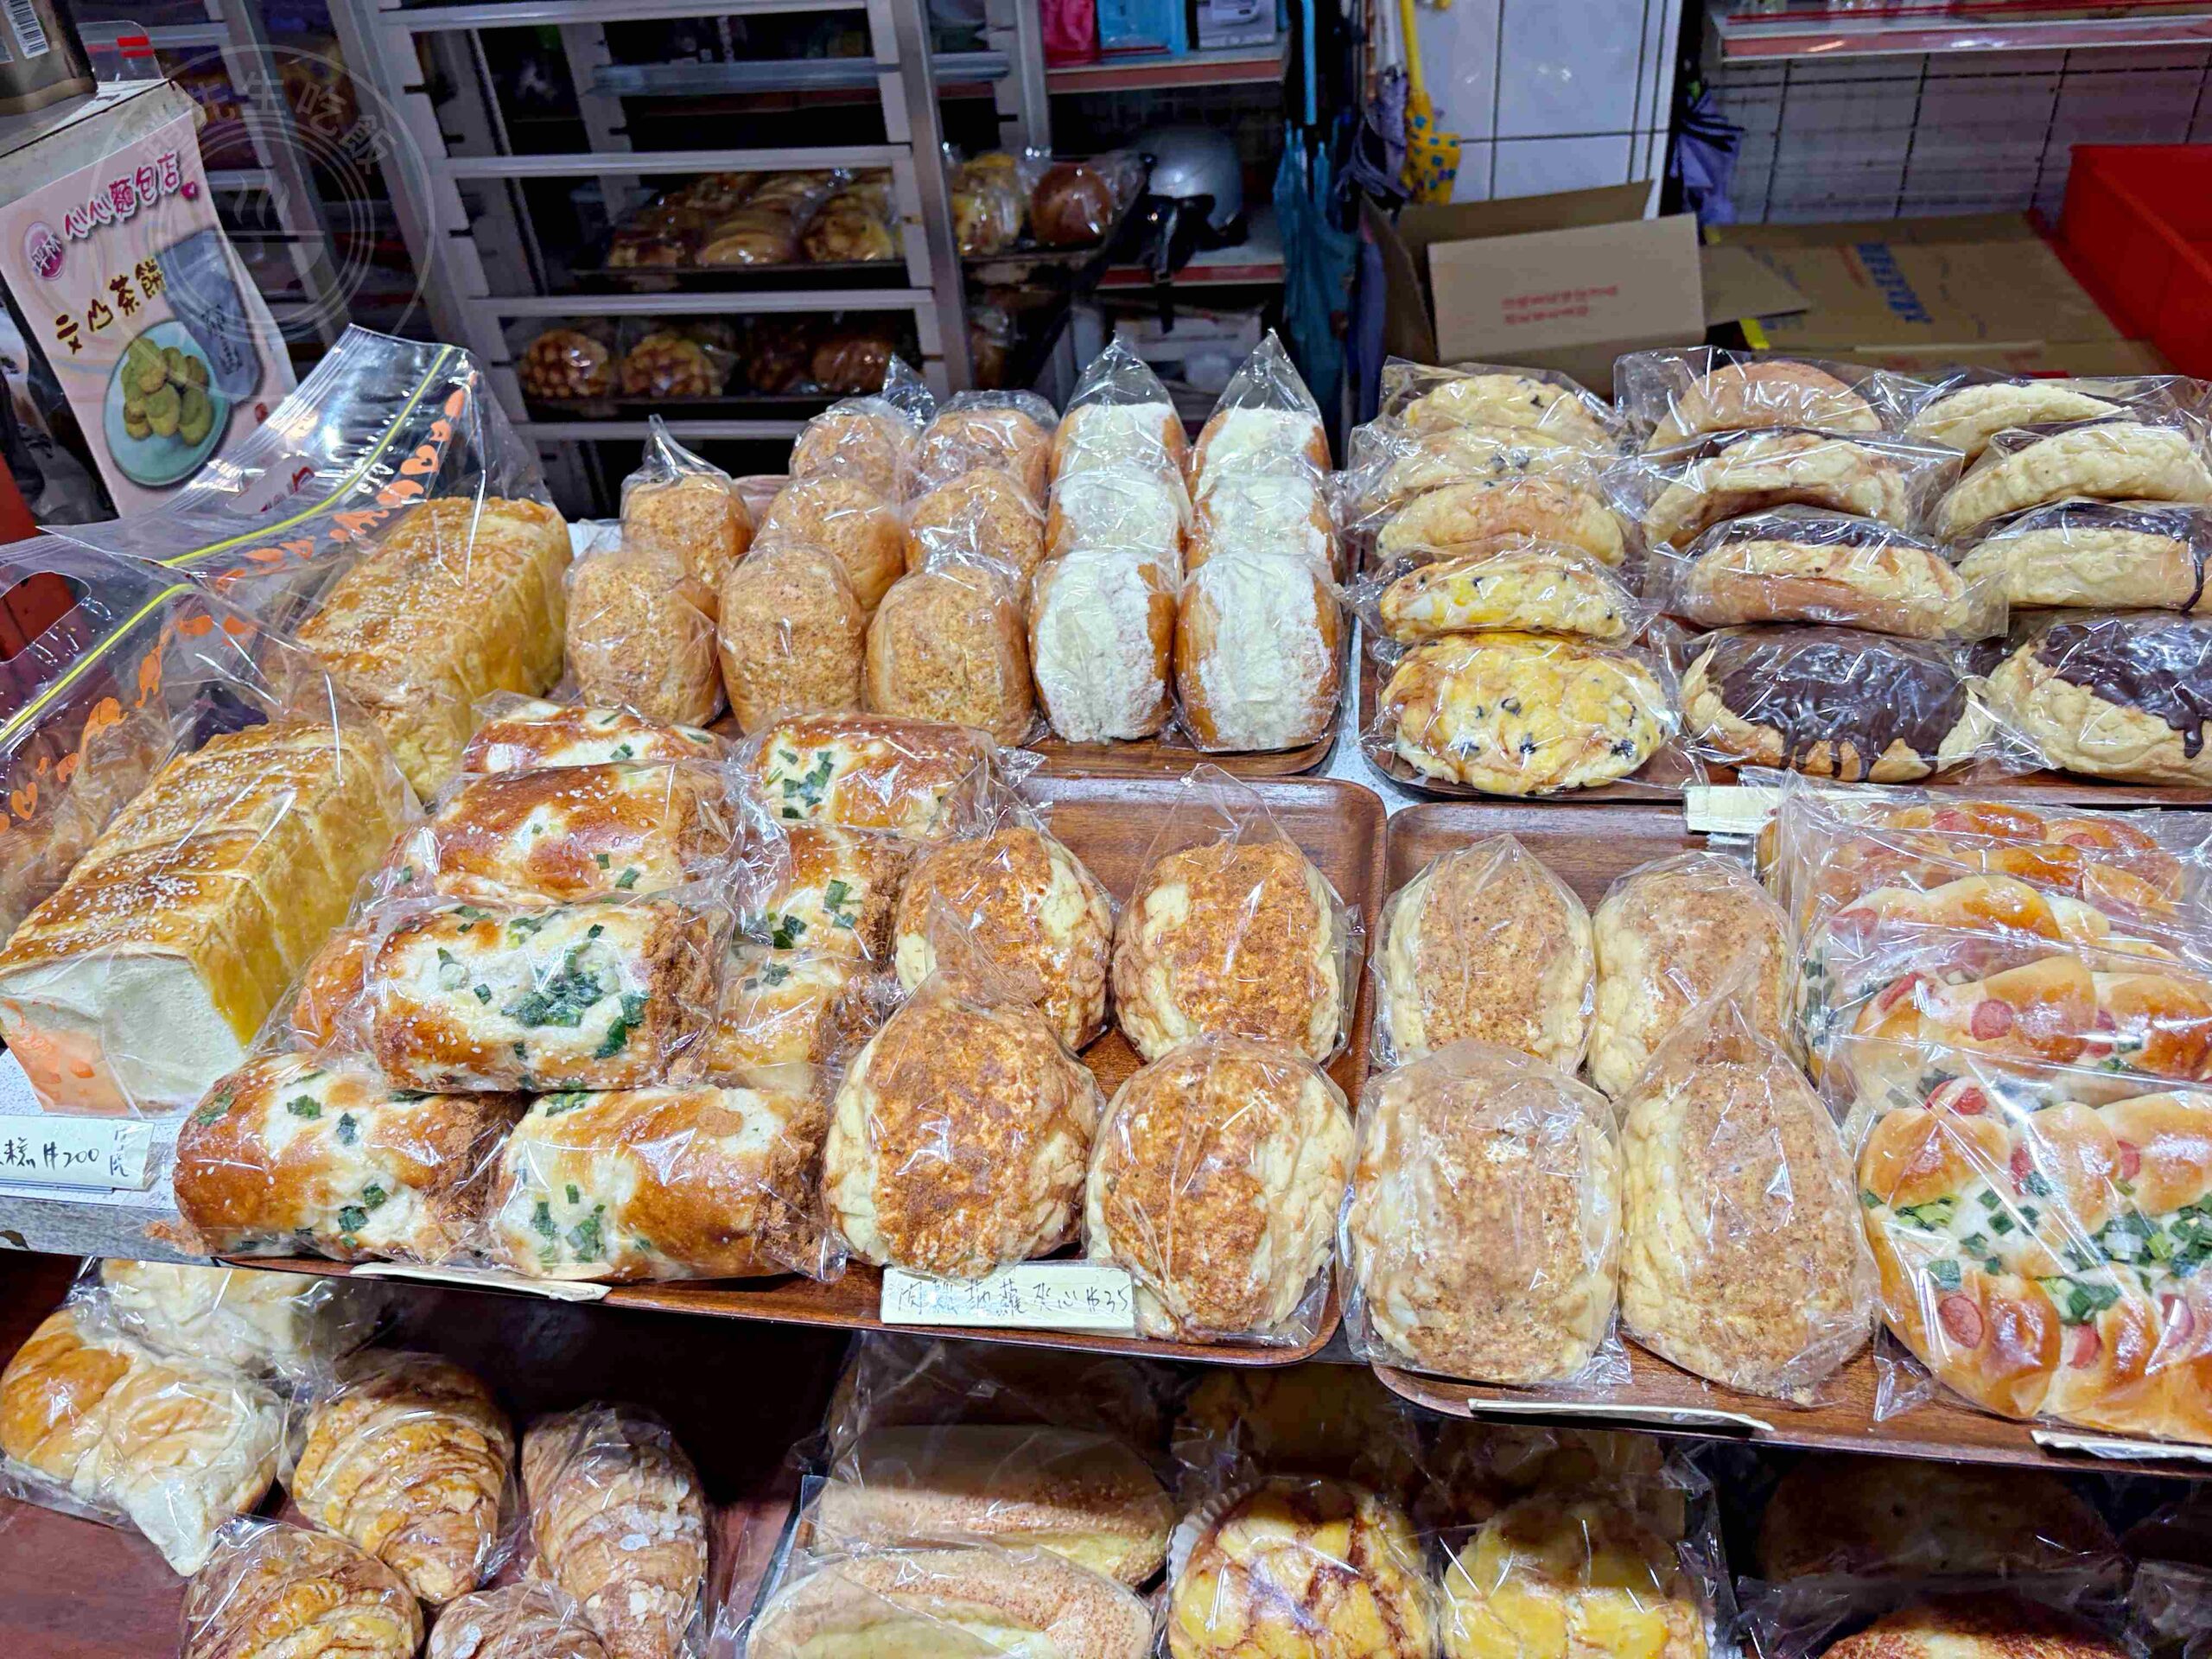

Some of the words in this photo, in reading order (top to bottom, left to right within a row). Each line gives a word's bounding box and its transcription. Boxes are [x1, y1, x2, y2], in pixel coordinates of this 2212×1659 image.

[63, 150, 180, 239] 心心麵包店
[55, 258, 166, 355] 文山茶餅
[0, 1137, 36, 1168] 糕
